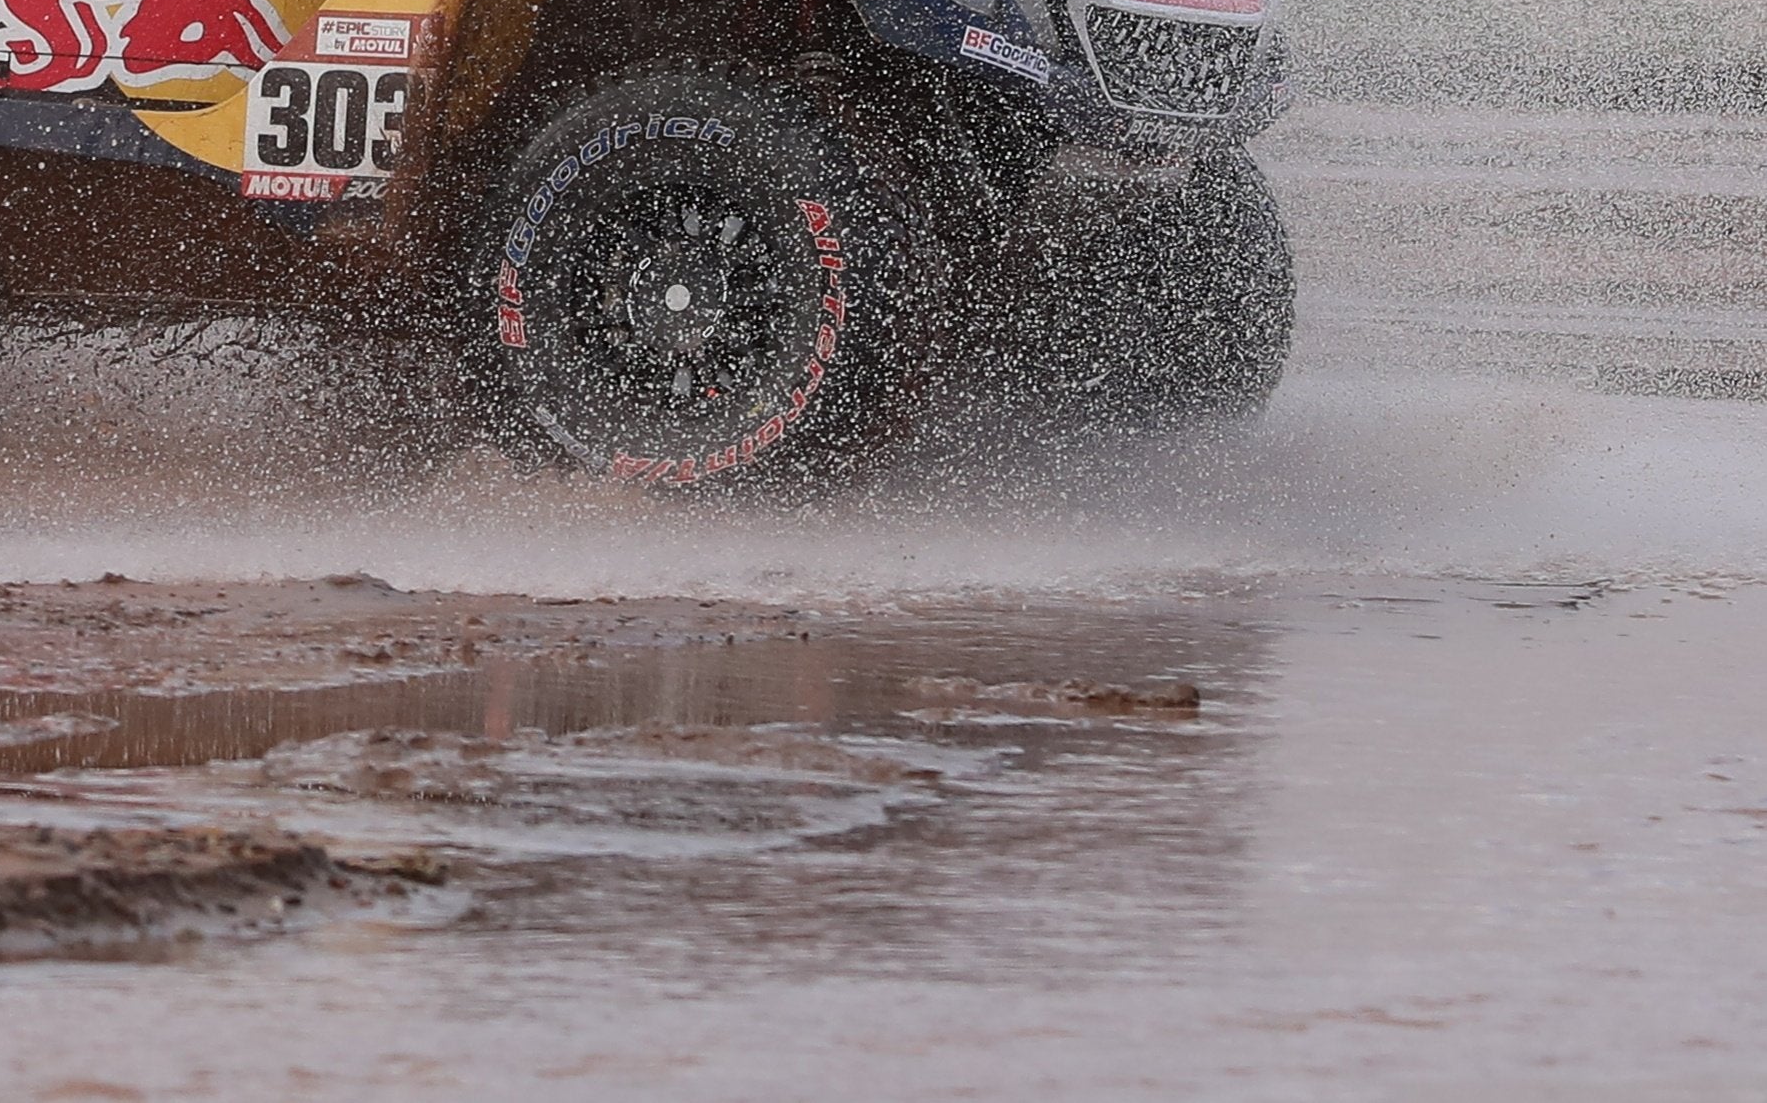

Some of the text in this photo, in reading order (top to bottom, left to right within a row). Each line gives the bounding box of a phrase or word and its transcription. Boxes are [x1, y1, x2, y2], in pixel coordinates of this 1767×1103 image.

[334, 38, 403, 53] by MOTUL
[245, 175, 334, 198] MOTUL
[498, 113, 736, 348] BFGoodrich
